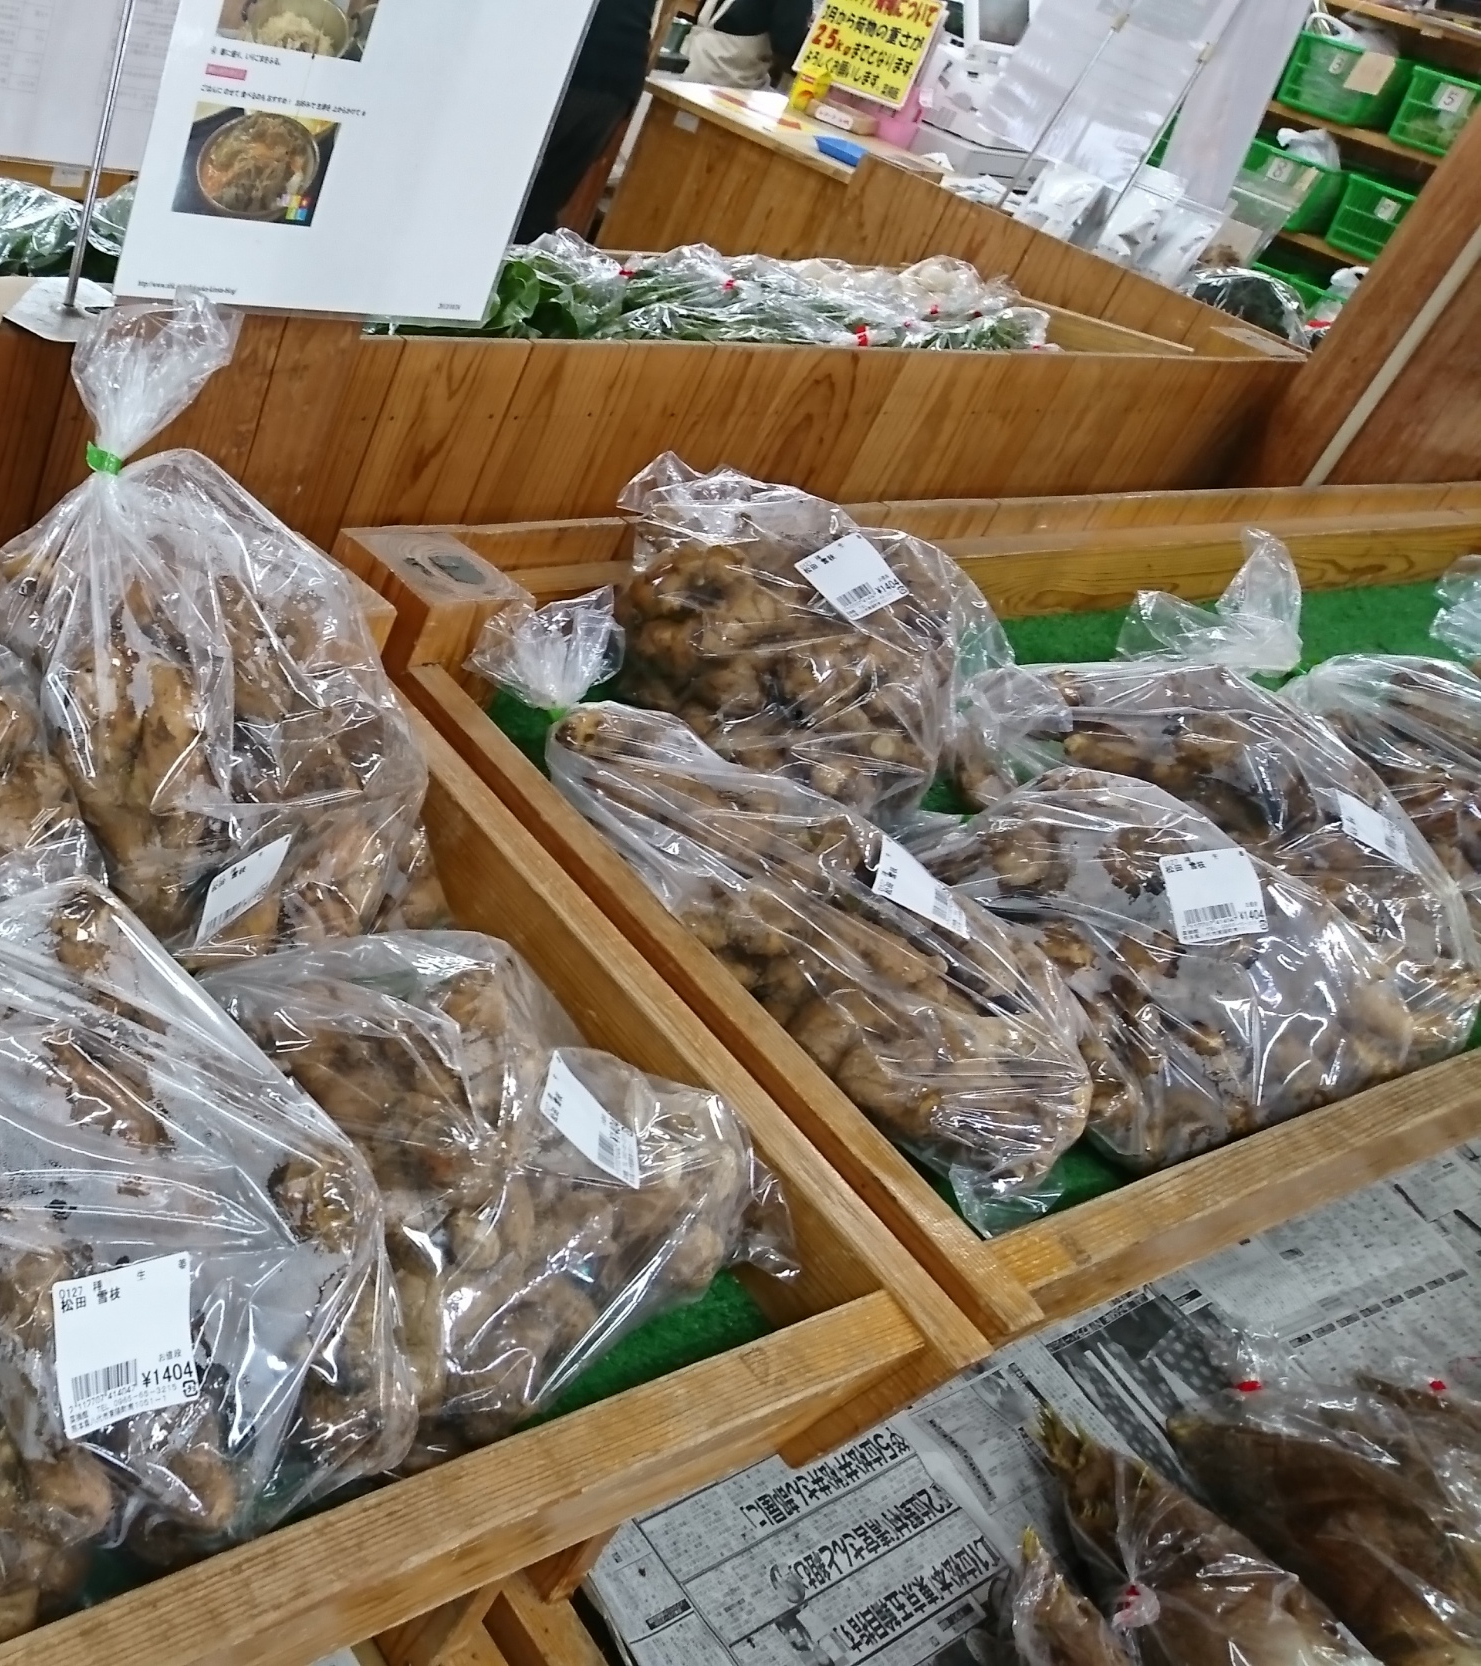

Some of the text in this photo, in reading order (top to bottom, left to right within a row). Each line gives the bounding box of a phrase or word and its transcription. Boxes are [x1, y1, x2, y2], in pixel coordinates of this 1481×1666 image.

[1443, 90, 1458, 106] 5
[1273, 160, 1288, 178] 8
[875, 579, 900, 594] ¥1404
[59, 1286, 83, 1299] 0127
[60, 1287, 120, 1313] 松田 雪枝
[158, 1349, 182, 1361] お値段
[141, 1361, 193, 1387] ¥1404
